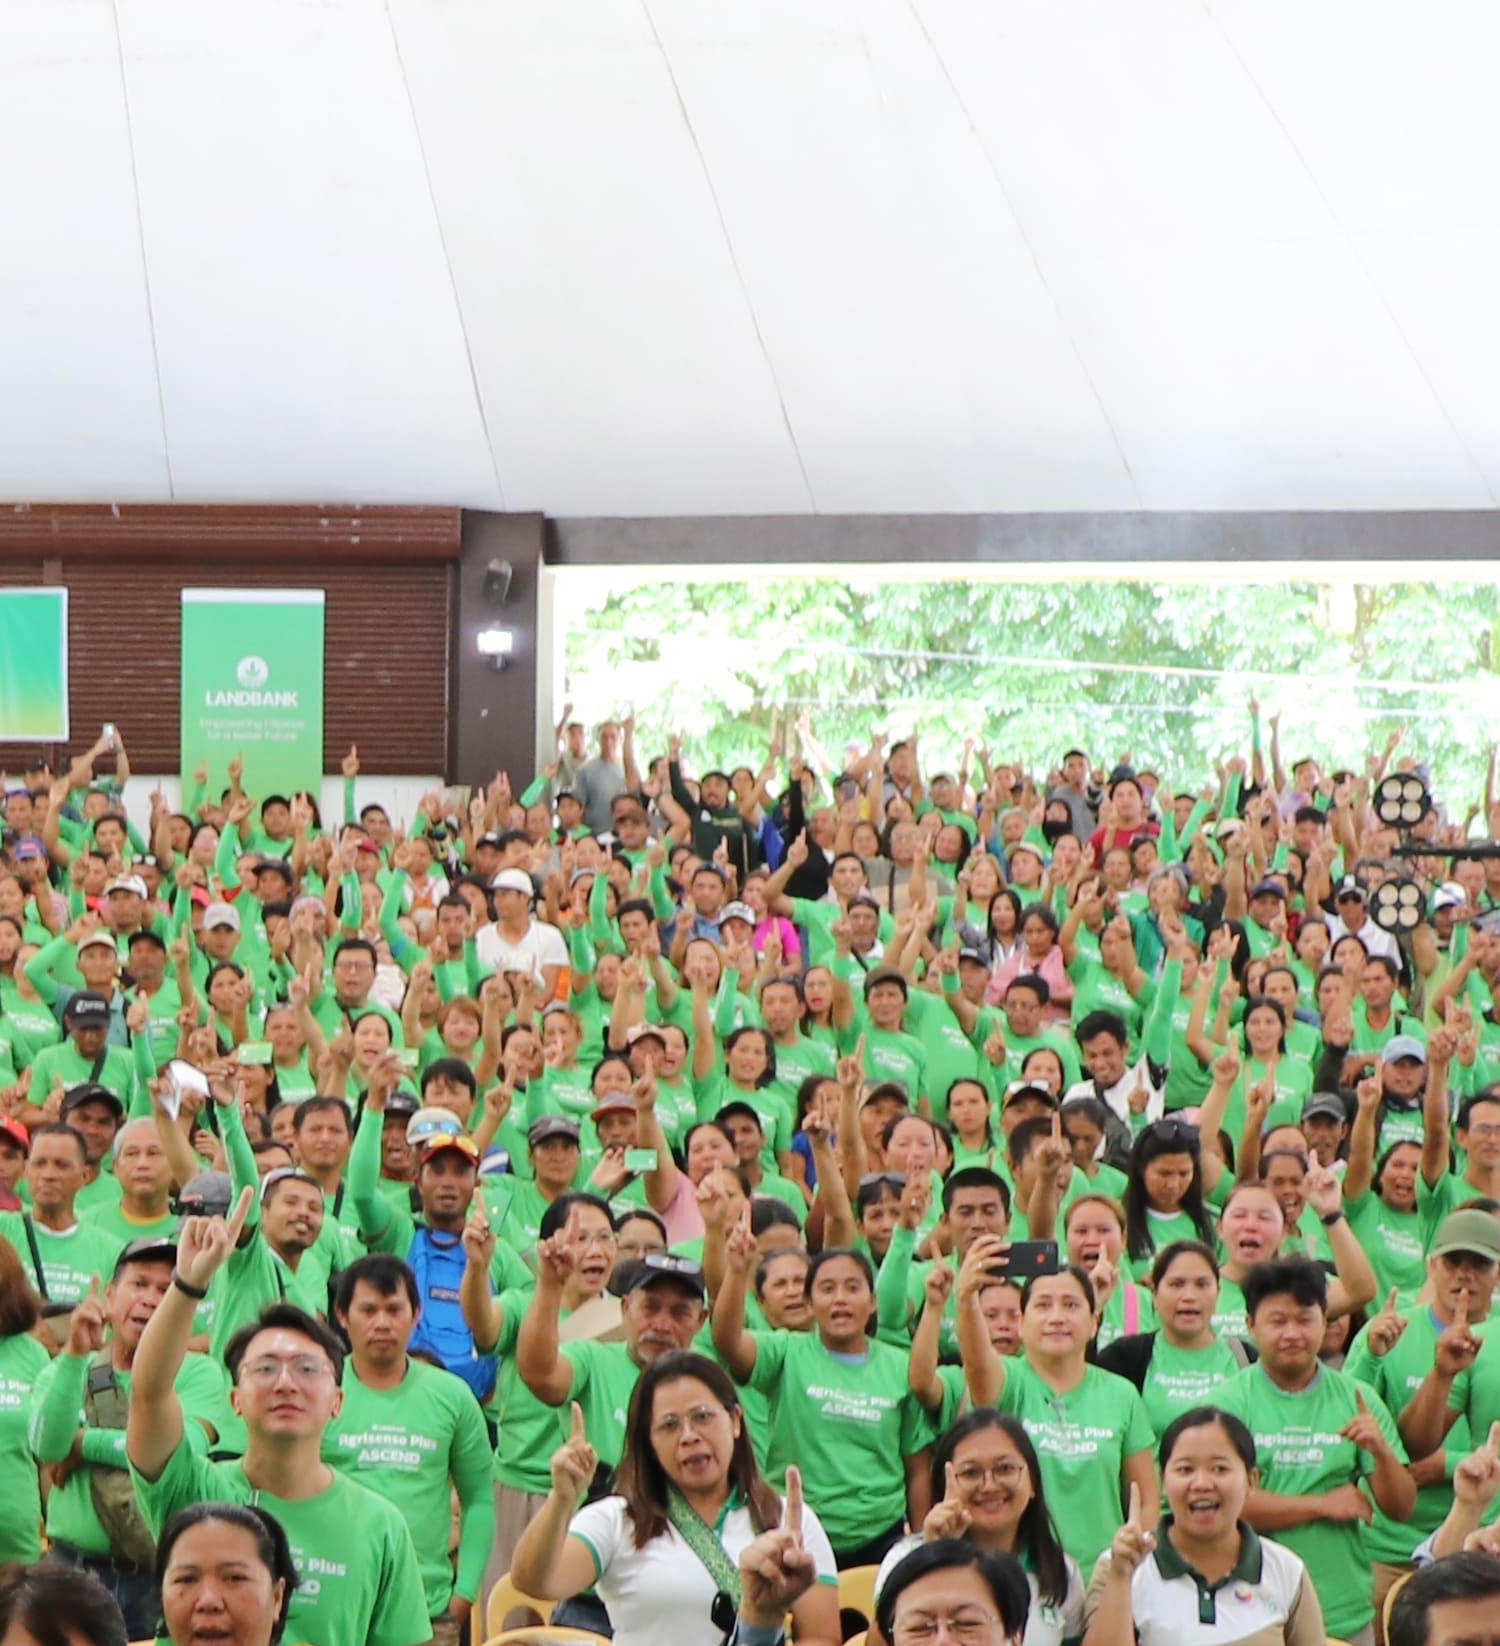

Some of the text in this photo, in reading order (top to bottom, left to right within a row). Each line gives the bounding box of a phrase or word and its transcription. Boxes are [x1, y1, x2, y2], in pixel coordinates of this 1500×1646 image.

[205, 690, 297, 707] LANDBANK
[822, 1401, 882, 1423] ASCEND
[1084, 1424, 1114, 1439] Plus
[1313, 1431, 1342, 1445] Plus
[339, 1430, 437, 1451] Agrisenso Plus
[358, 1449, 421, 1466] ASCEND
[308, 1557, 346, 1577] Plus
